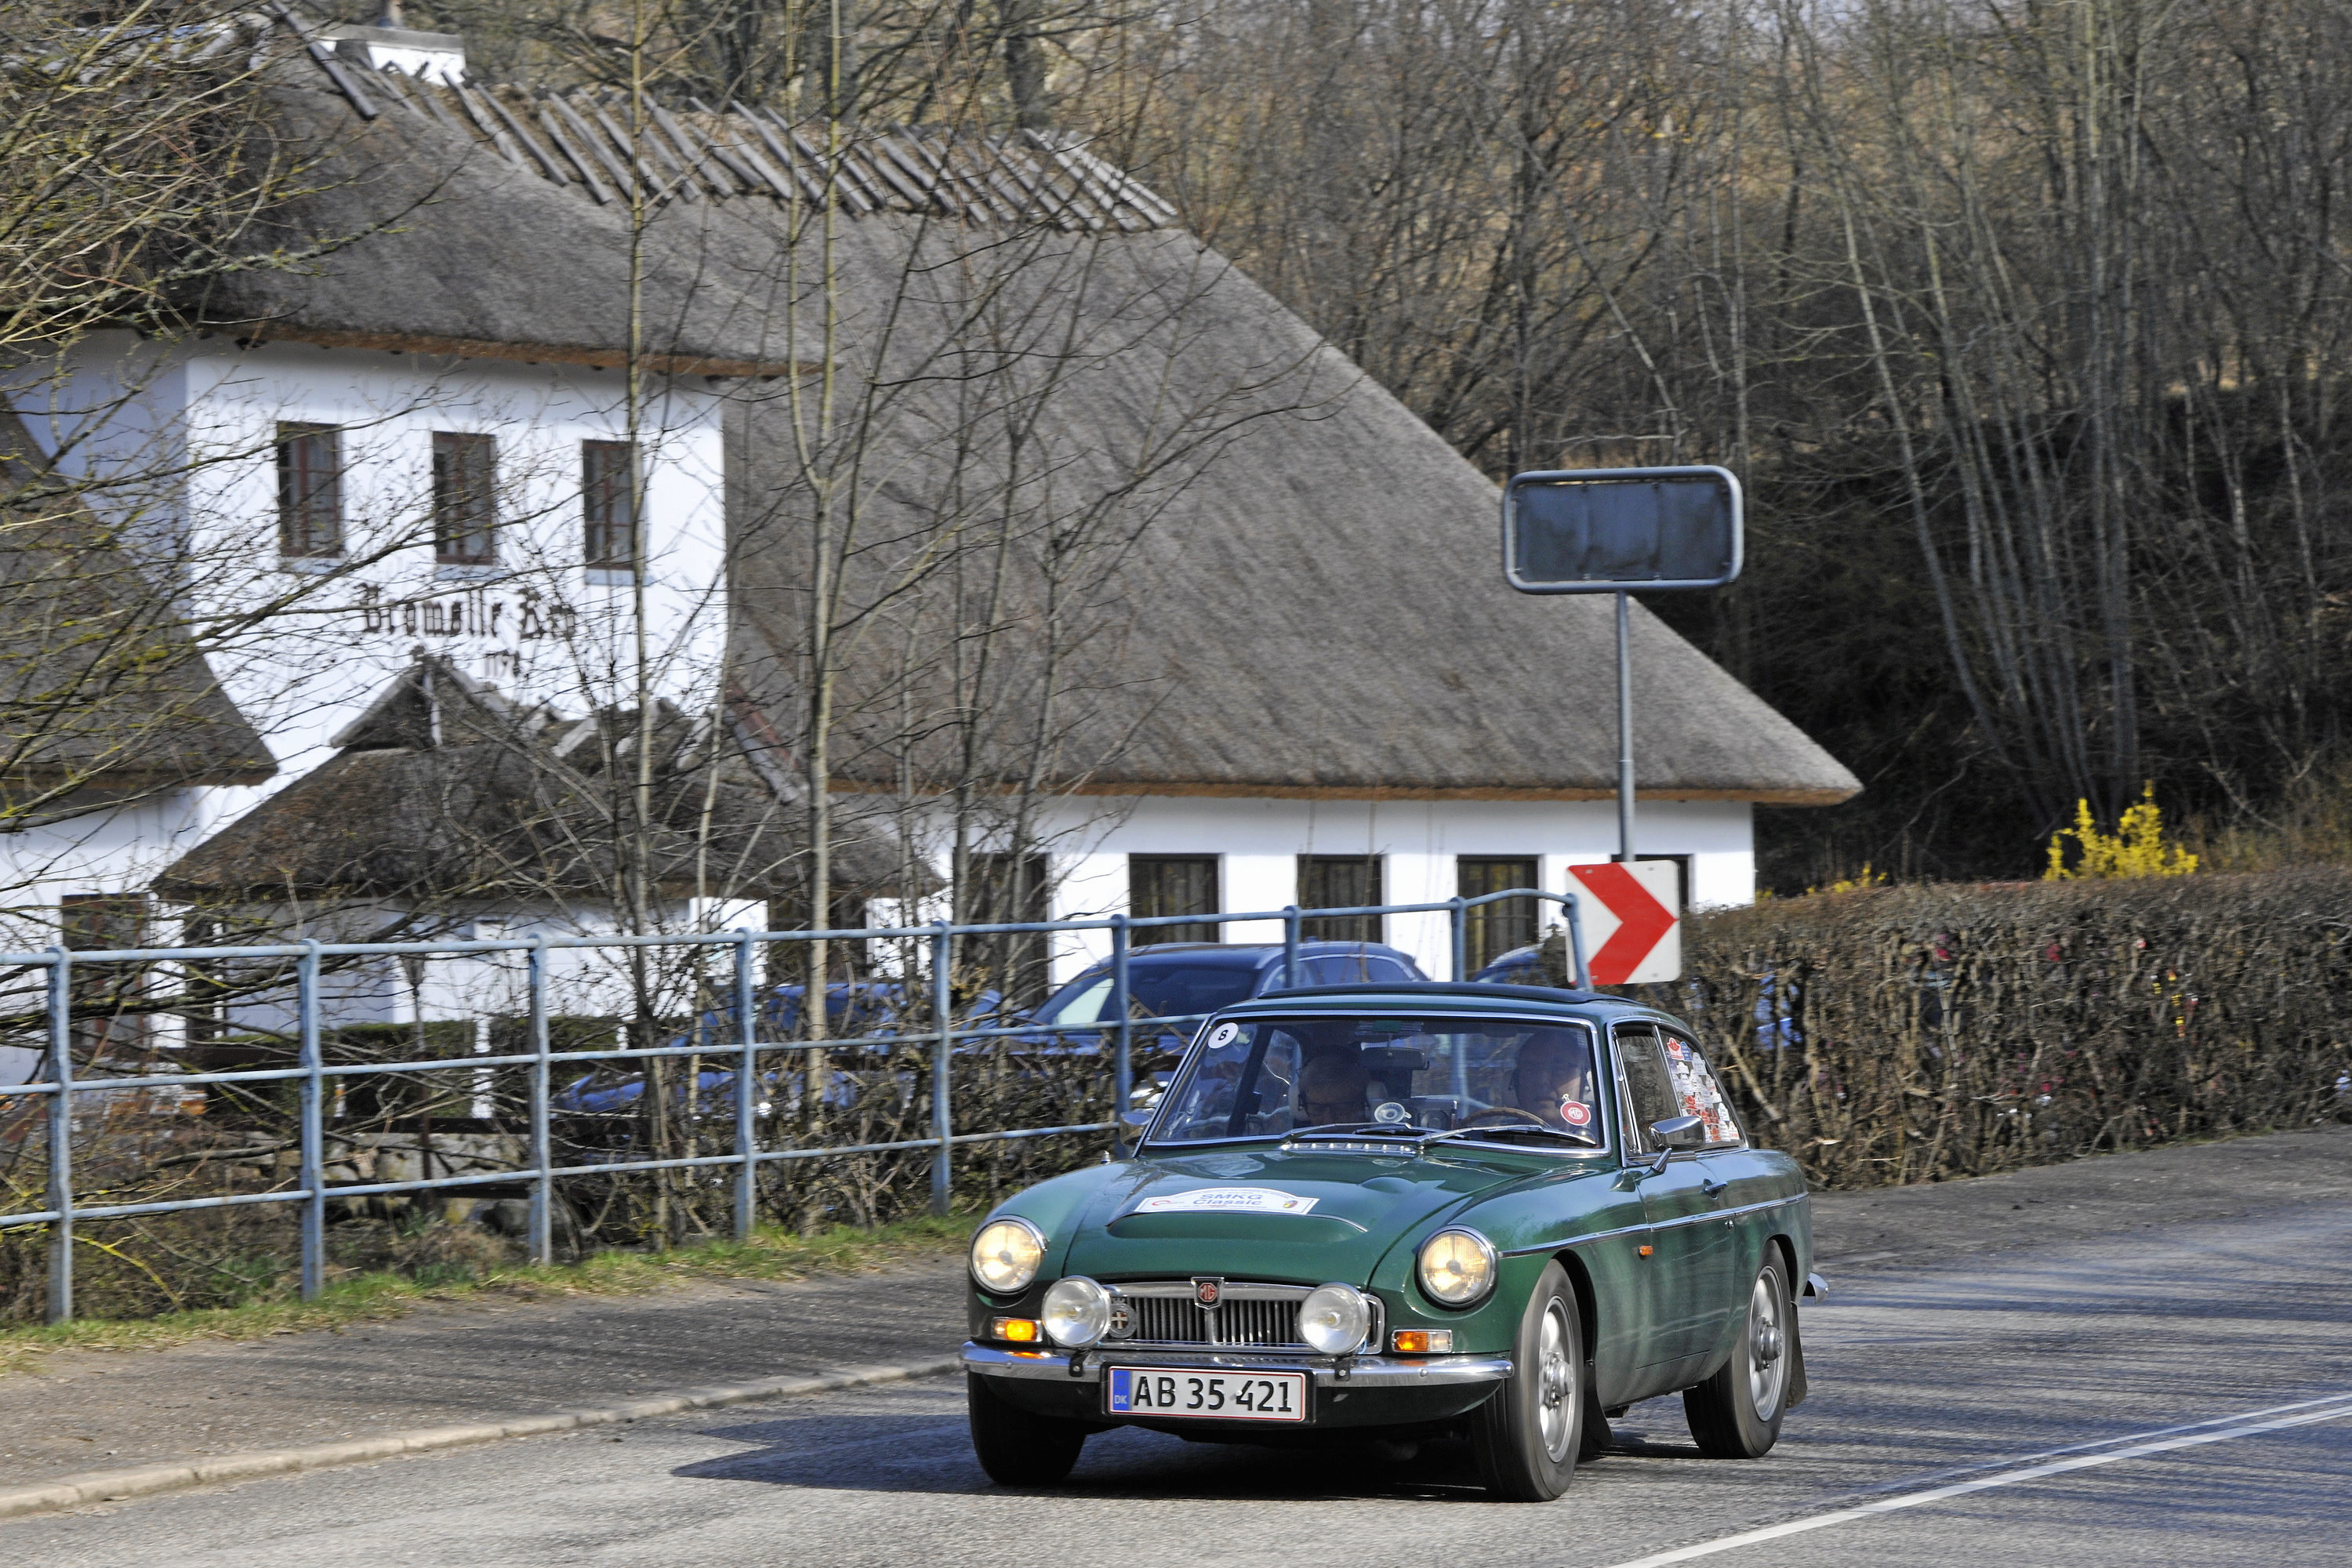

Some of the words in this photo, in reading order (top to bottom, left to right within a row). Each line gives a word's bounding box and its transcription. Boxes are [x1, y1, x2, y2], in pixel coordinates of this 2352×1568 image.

[1218, 1029, 1229, 1040] 8
[1199, 1284, 1216, 1301] MG
[1114, 1395, 1127, 1404] DK
[1134, 1376, 1176, 1407] AB
[1187, 1377, 1225, 1410] 35
[1236, 1380, 1292, 1412] 421
